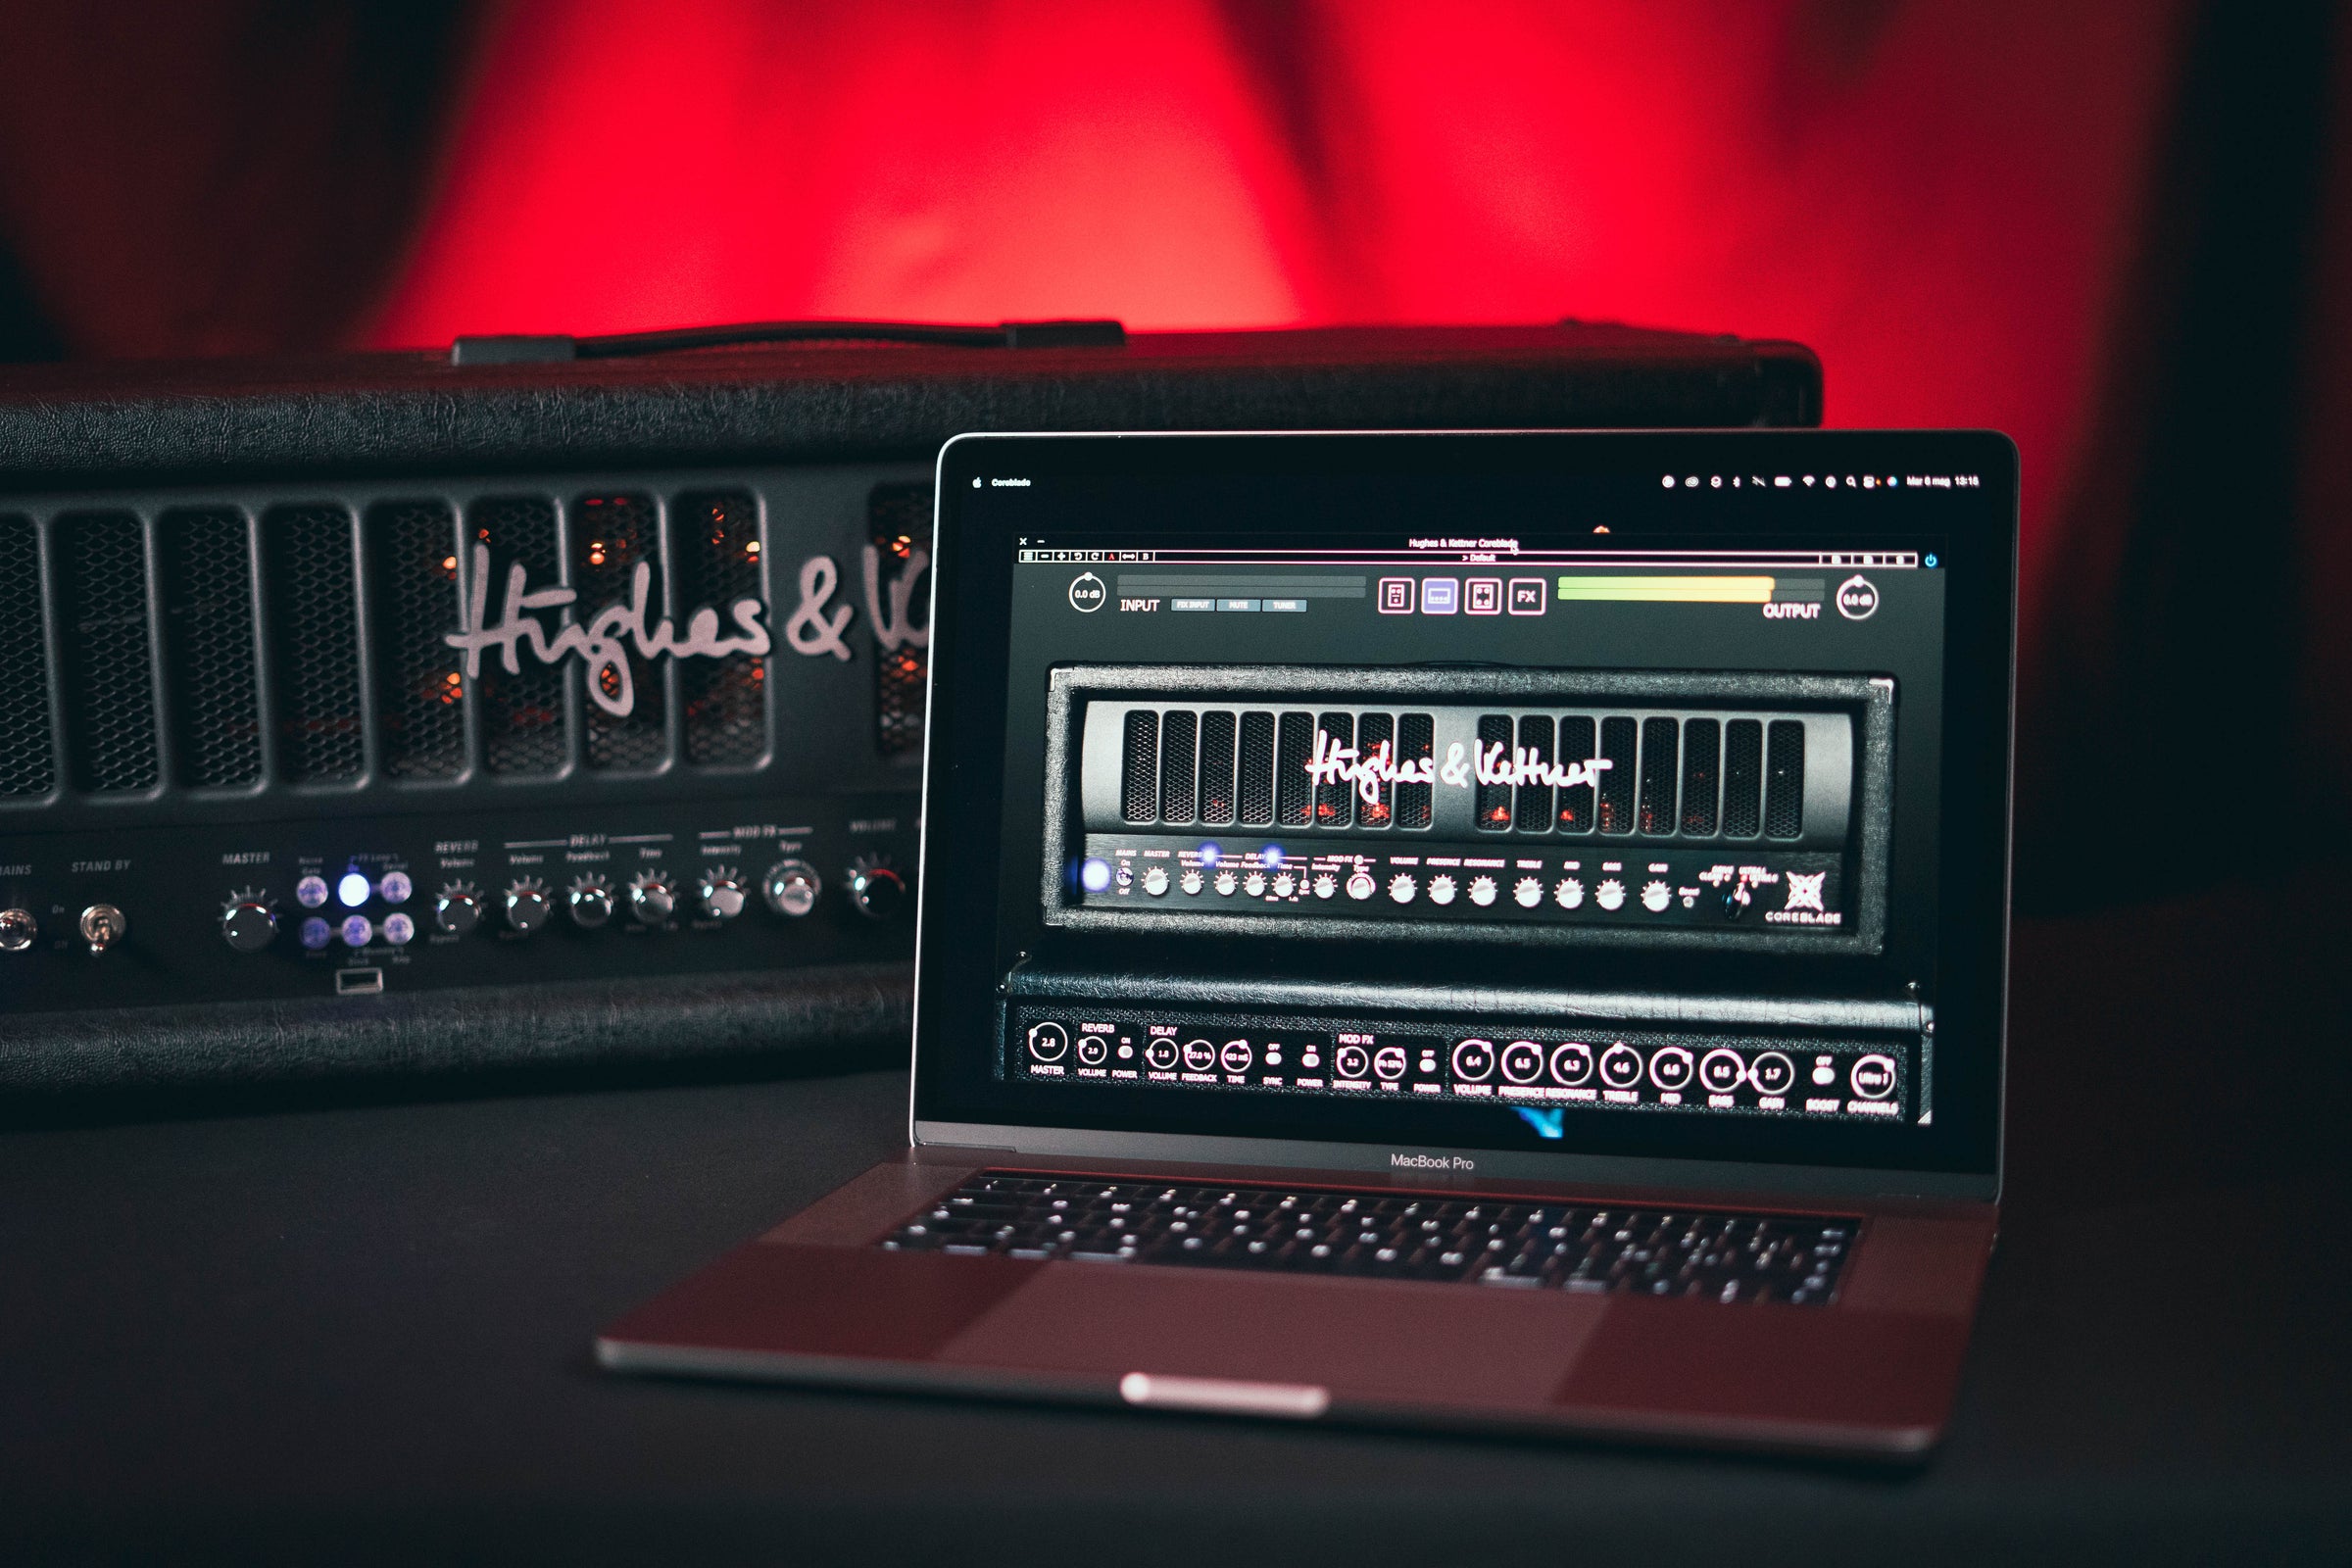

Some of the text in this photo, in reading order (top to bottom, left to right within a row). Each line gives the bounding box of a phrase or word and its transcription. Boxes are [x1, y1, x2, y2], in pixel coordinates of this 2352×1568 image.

[1408, 538, 1439, 549] Hughes
[1448, 538, 1478, 548] Kettner
[1074, 590, 1101, 599] 0.0 dB
[1517, 590, 1536, 603] FX
[1120, 599, 1160, 612] INPUT
[1229, 601, 1249, 610] MUTE
[1273, 601, 1297, 610] TUNER
[1763, 603, 1821, 618] OUTPUT
[445, 543, 771, 717] Hughes
[786, 556, 854, 661] &
[1305, 729, 1613, 805] Hughes & Kettner
[221, 852, 270, 864] MASTER
[1115, 849, 1137, 858] MAINS
[1144, 850, 1171, 858] MASTER
[72, 859, 131, 873] STAND BY
[1390, 856, 1419, 865] VOLUME
[1765, 911, 1841, 924] COREBLADE
[1081, 1023, 1114, 1033] REVERB
[1150, 1026, 1177, 1036] DELAY
[1041, 1038, 1055, 1048] 2.8
[1339, 1034, 1374, 1045] MOD FX
[1030, 1064, 1064, 1075] MASTER
[1078, 1068, 1138, 1079] VOLUME POWER
[1149, 1071, 1323, 1088] VOLUME FEEDBACK TIME SYNC POWER
[1333, 1080, 1441, 1094] INTENSITY TYPE POWER
[1453, 1084, 1899, 1115] VOLUME PRESENCE RESONANCE TREBLE MID BASS GAIN BOOST CHANNELS
[1392, 1153, 1474, 1169] MacBook Pro
